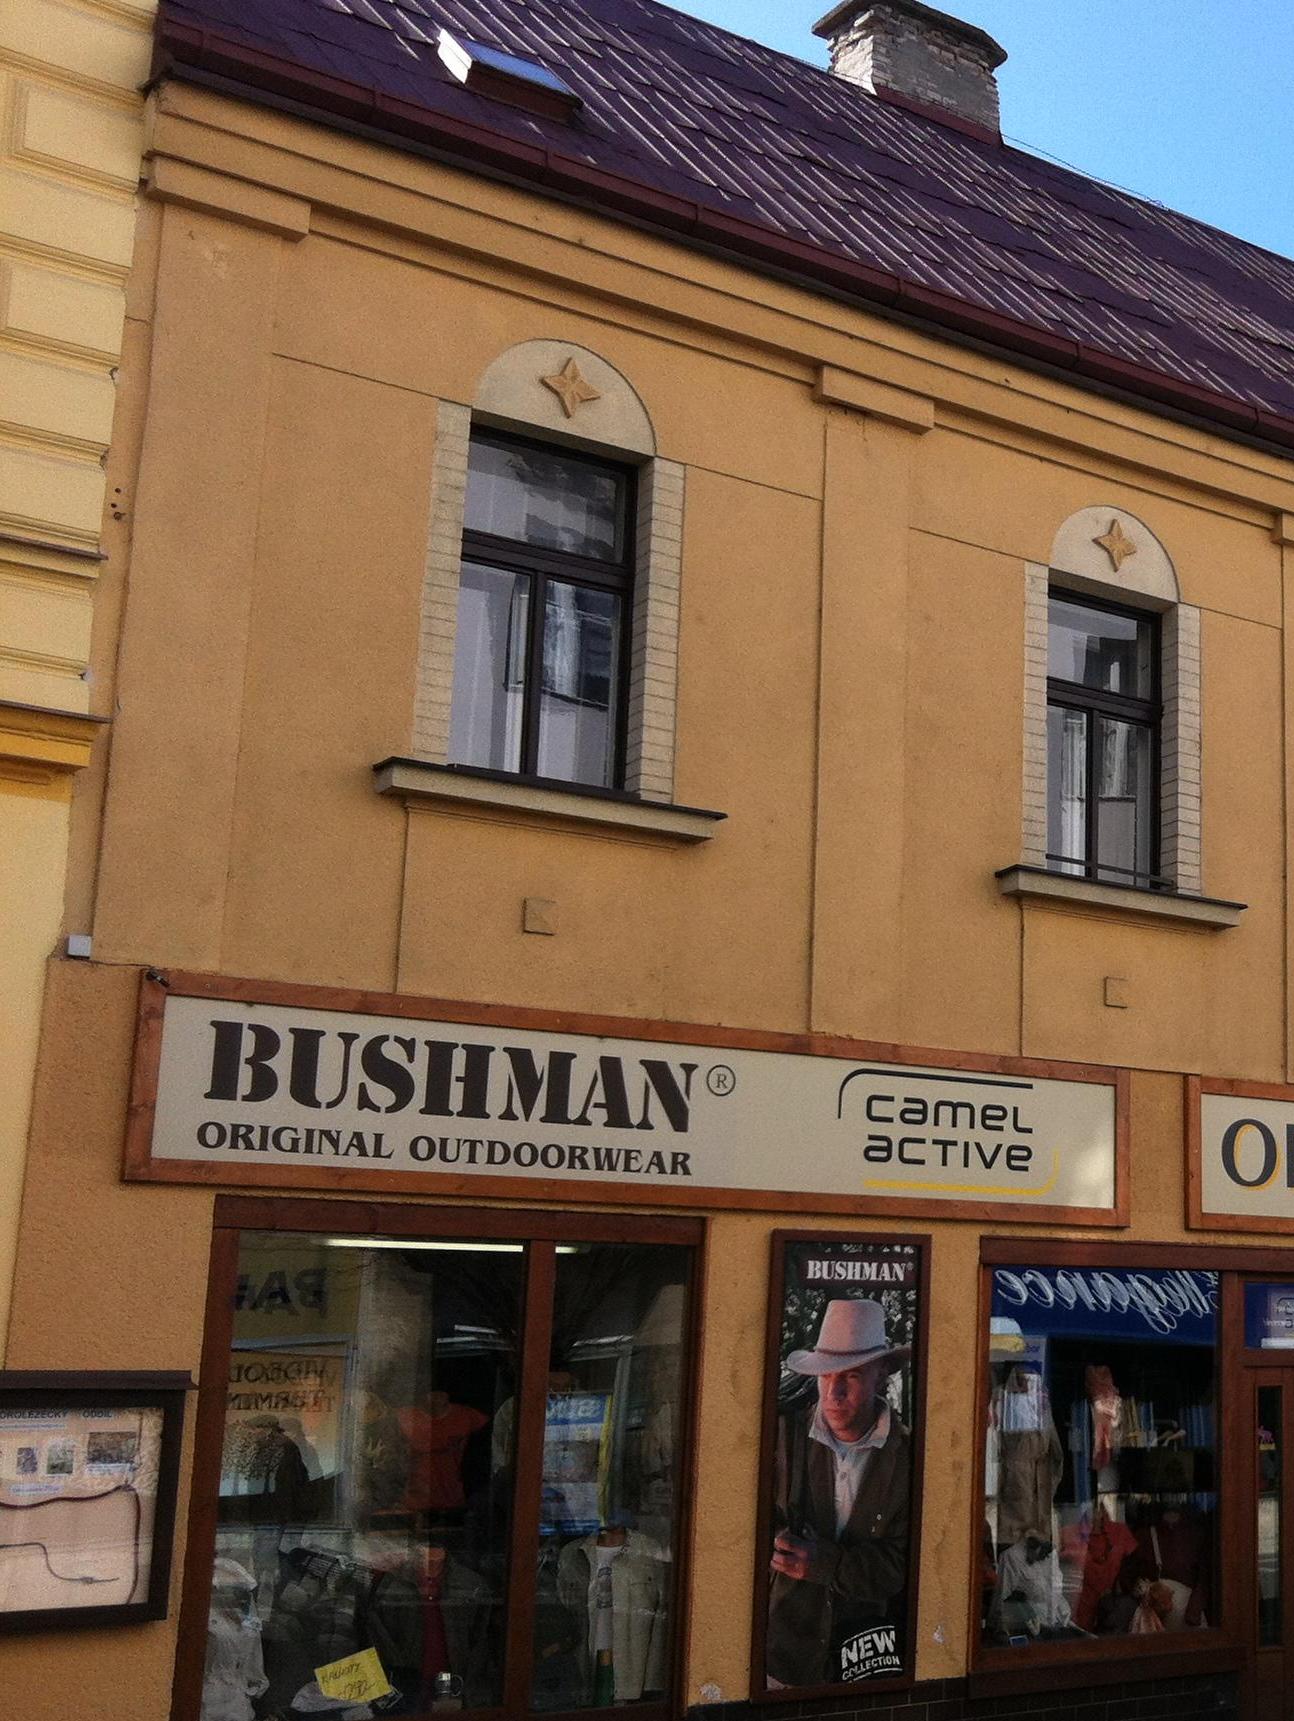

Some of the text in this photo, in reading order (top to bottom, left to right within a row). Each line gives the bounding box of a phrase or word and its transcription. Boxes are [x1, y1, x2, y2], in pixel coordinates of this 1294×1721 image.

[204, 1020, 698, 1133] BUSHMAN
[197, 1121, 693, 1176] ORIGINAL OUTDOORWEAR
[806, 1260, 906, 1282] BUSHMAN
[841, 1630, 896, 1669] NEW
[842, 1655, 901, 1681] COLLECTION
